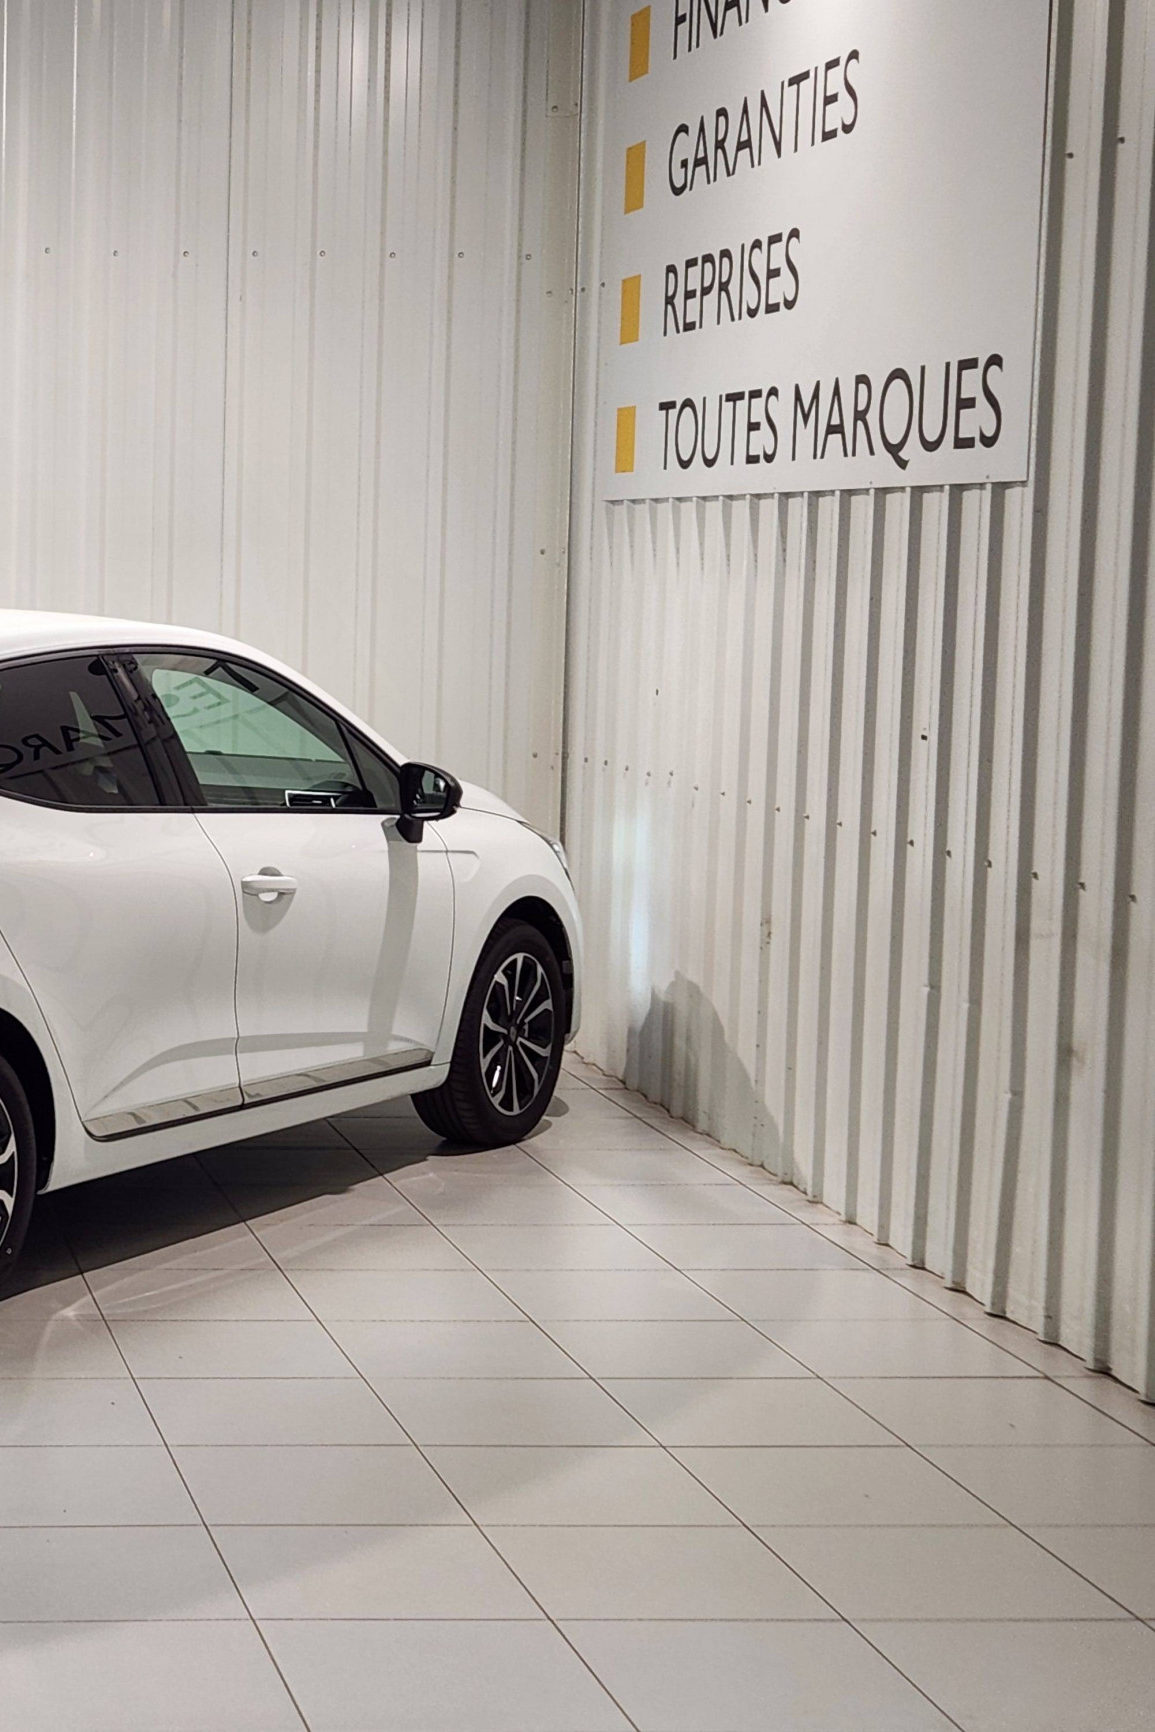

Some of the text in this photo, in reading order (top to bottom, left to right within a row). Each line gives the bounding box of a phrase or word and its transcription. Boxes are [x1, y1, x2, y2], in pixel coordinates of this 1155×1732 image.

[668, 49, 860, 197] GARANTIES
[663, 227, 800, 337] REPRISES
[658, 353, 1004, 471] TOUTES MARQUES
